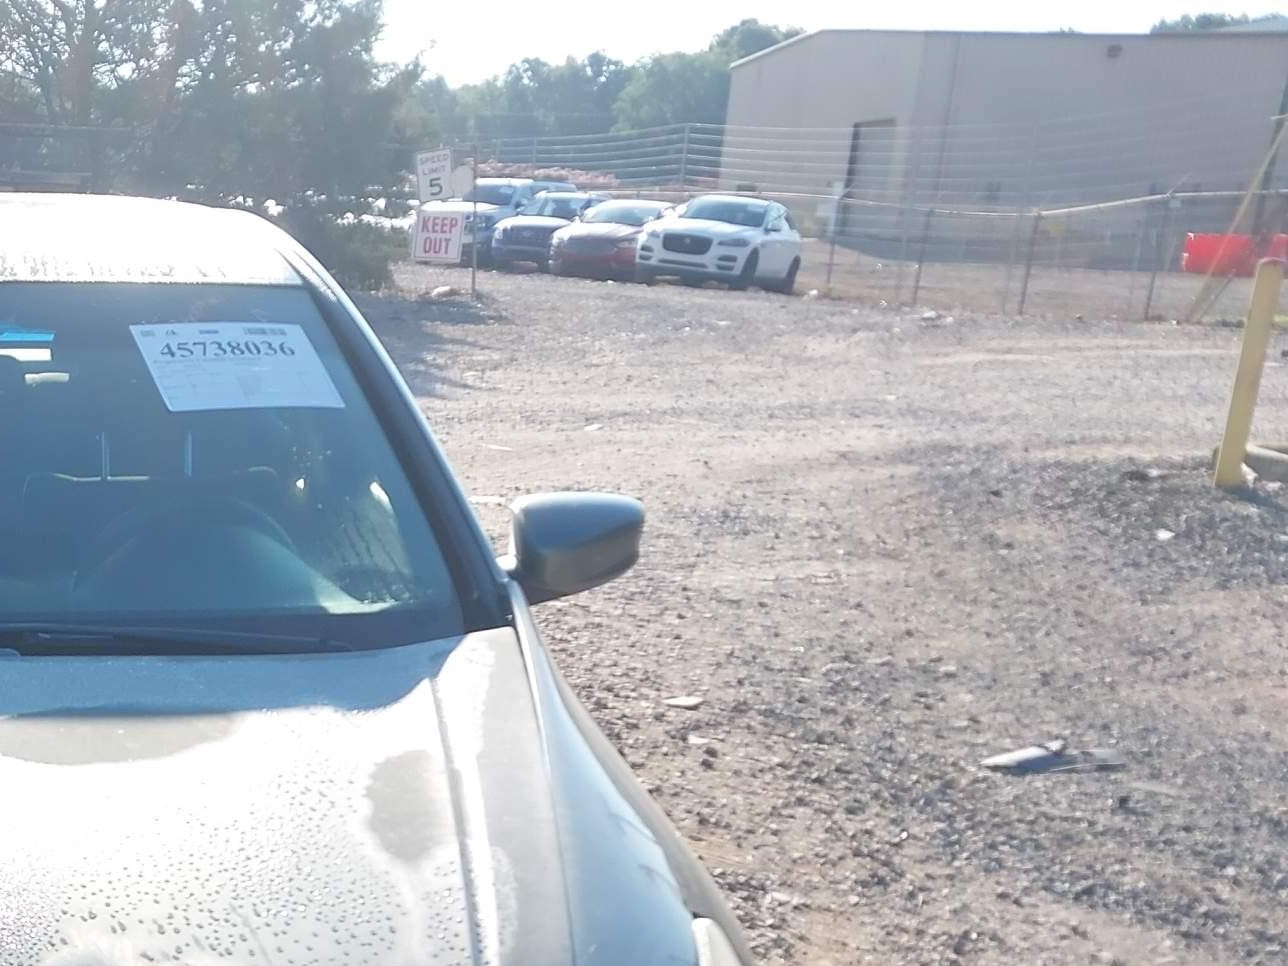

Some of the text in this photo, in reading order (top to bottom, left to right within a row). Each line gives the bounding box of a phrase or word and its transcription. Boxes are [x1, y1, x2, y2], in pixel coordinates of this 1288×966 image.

[420, 153, 449, 164] SPEED
[422, 165, 447, 176] LIMIT
[429, 177, 444, 196] 5
[421, 215, 459, 234] KEEP
[423, 236, 452, 255] OUT
[159, 340, 296, 358] 45738036
